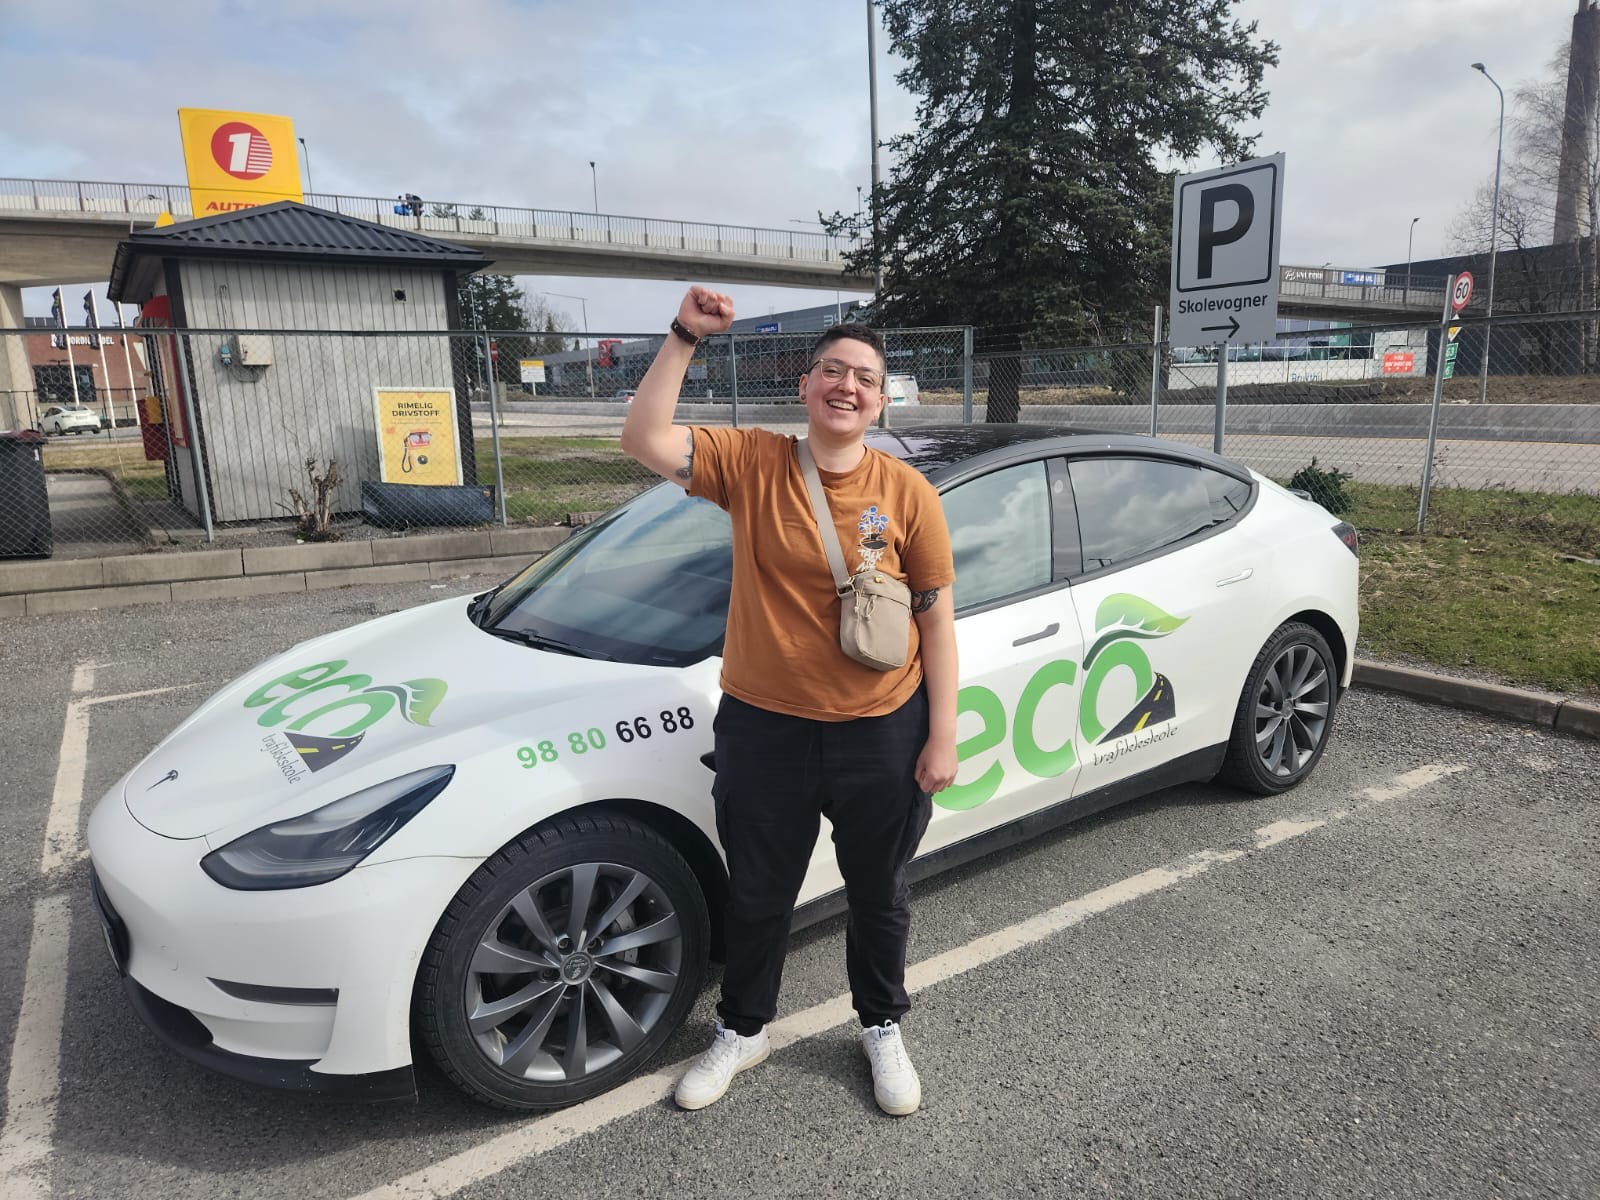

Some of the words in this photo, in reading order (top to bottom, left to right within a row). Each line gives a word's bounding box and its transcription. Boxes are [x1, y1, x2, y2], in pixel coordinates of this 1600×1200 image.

[228, 132, 251, 173] 1
[1197, 183, 1255, 280] P
[1178, 294, 1268, 315] Skolevogner
[1455, 282, 1470, 300] 60
[243, 659, 396, 737] eco
[516, 746, 559, 769] 98
[567, 727, 607, 755] 80
[615, 716, 652, 743] 66
[659, 706, 695, 734] 88
[931, 640, 1153, 811] eco
[1093, 722, 1179, 767] trafikkskole
[261, 733, 308, 785] trafikkskole
